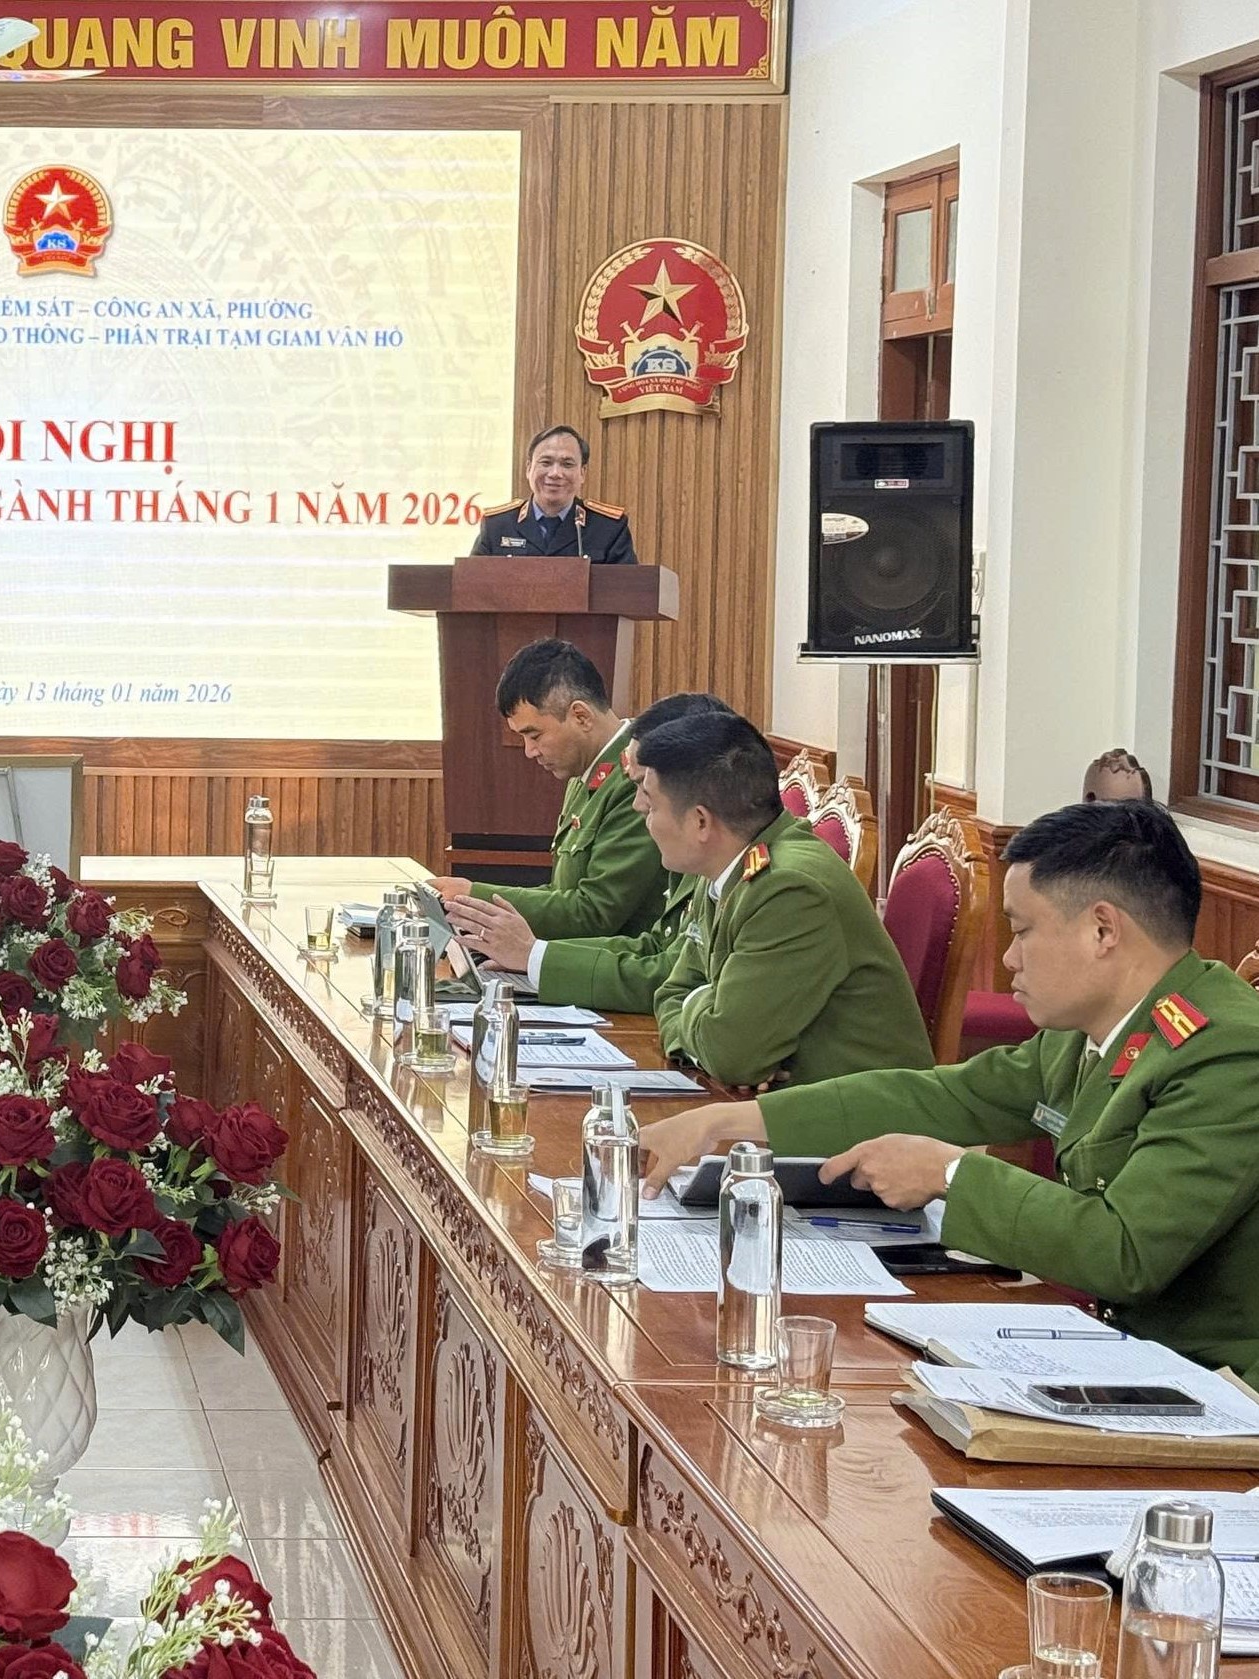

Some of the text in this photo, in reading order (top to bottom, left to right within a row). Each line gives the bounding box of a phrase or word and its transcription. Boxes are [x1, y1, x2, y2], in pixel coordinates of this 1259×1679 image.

[220, 18, 360, 69] VINH
[386, 5, 566, 70] MUÔN
[596, 5, 739, 68] NĂM
[37, 296, 74, 317] SÁT
[94, 296, 151, 318] CÔNG
[156, 301, 183, 318] AN
[189, 298, 222, 321] XÃ,
[227, 298, 313, 319] PHƯỜNG
[13, 322, 84, 344] THÔNG
[105, 323, 158, 345] PHÂN
[163, 329, 211, 350] TRẠI
[217, 329, 261, 350] TẠM
[267, 329, 320, 346] GIAM
[328, 325, 367, 347] VÂN
[645, 357, 677, 373] KS
[40, 419, 179, 475] NGHỊ
[105, 480, 251, 525] THÁNG
[268, 491, 280, 525] 1
[296, 481, 390, 526] NĂM
[403, 491, 484, 526] 2026
[854, 627, 922, 646] NANOMAX
[26, 682, 47, 702] 13
[53, 681, 105, 707] tháng
[111, 682, 133, 703] 01
[139, 683, 180, 703] năm
[186, 683, 233, 703] 2026
